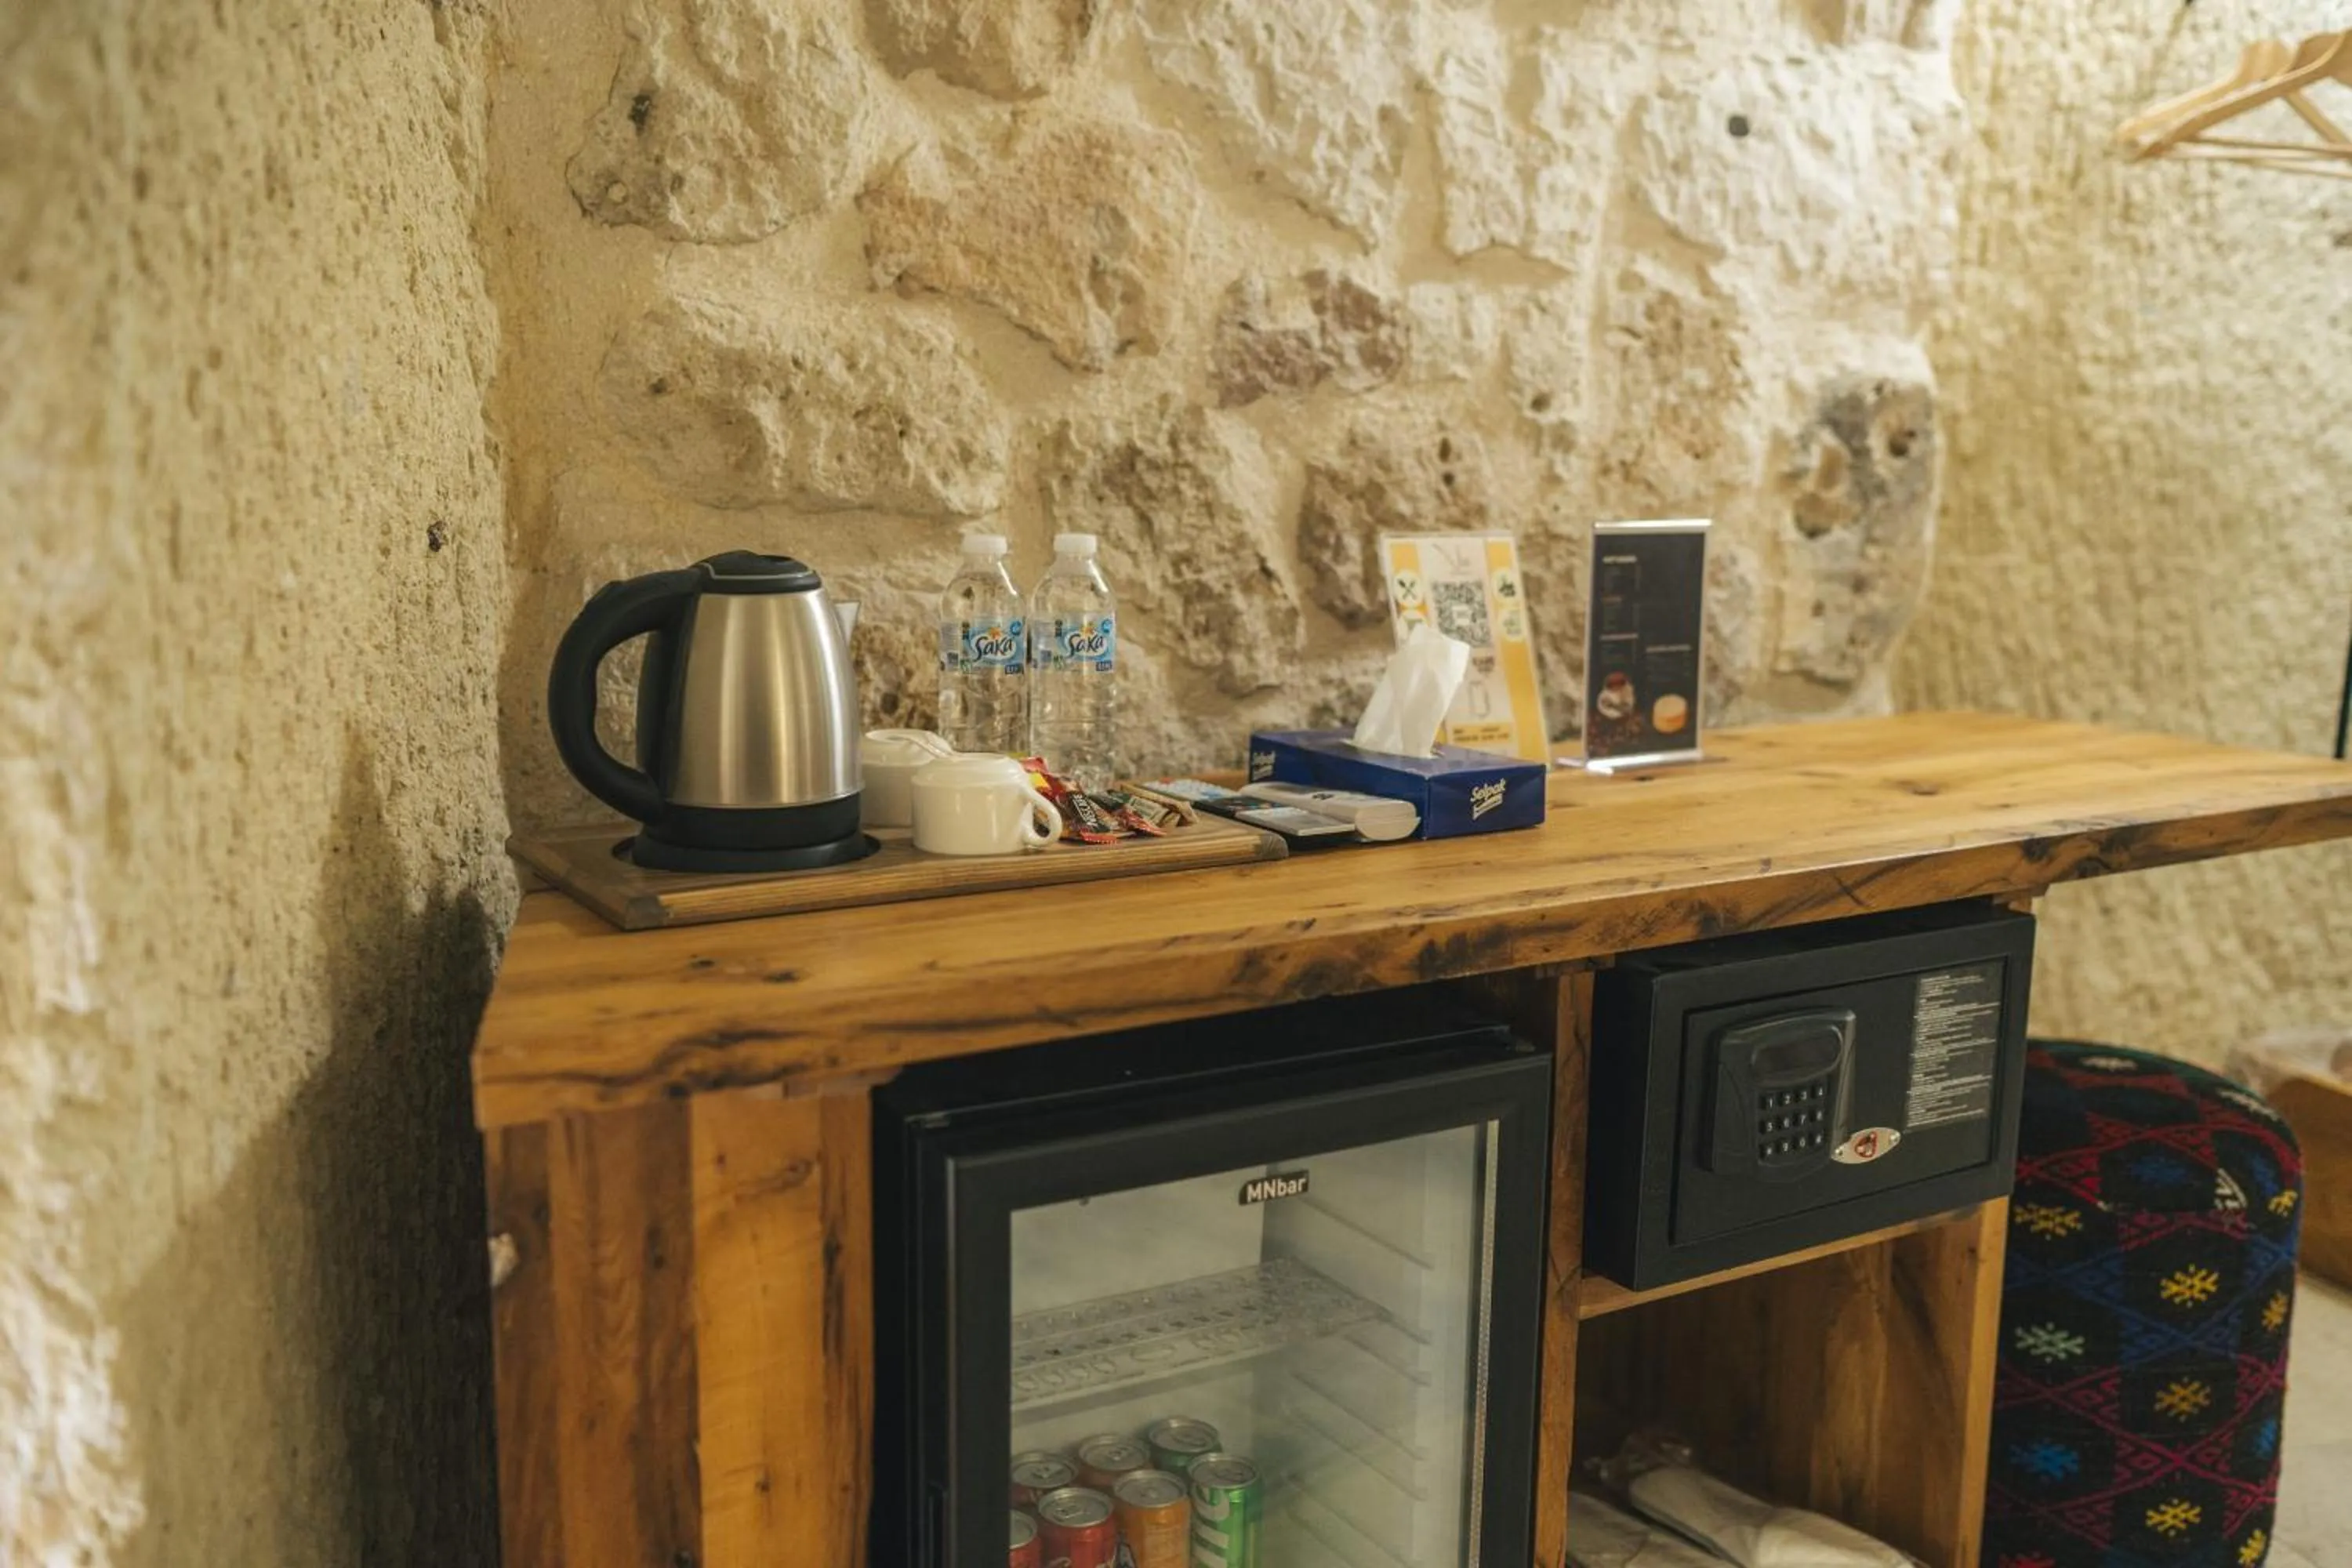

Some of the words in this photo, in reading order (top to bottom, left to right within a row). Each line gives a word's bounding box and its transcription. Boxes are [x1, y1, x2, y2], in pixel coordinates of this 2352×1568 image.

[973, 635, 1014, 662] Saka
[1065, 633, 1104, 658] Saka
[1247, 1178, 1306, 1203] MNbar
